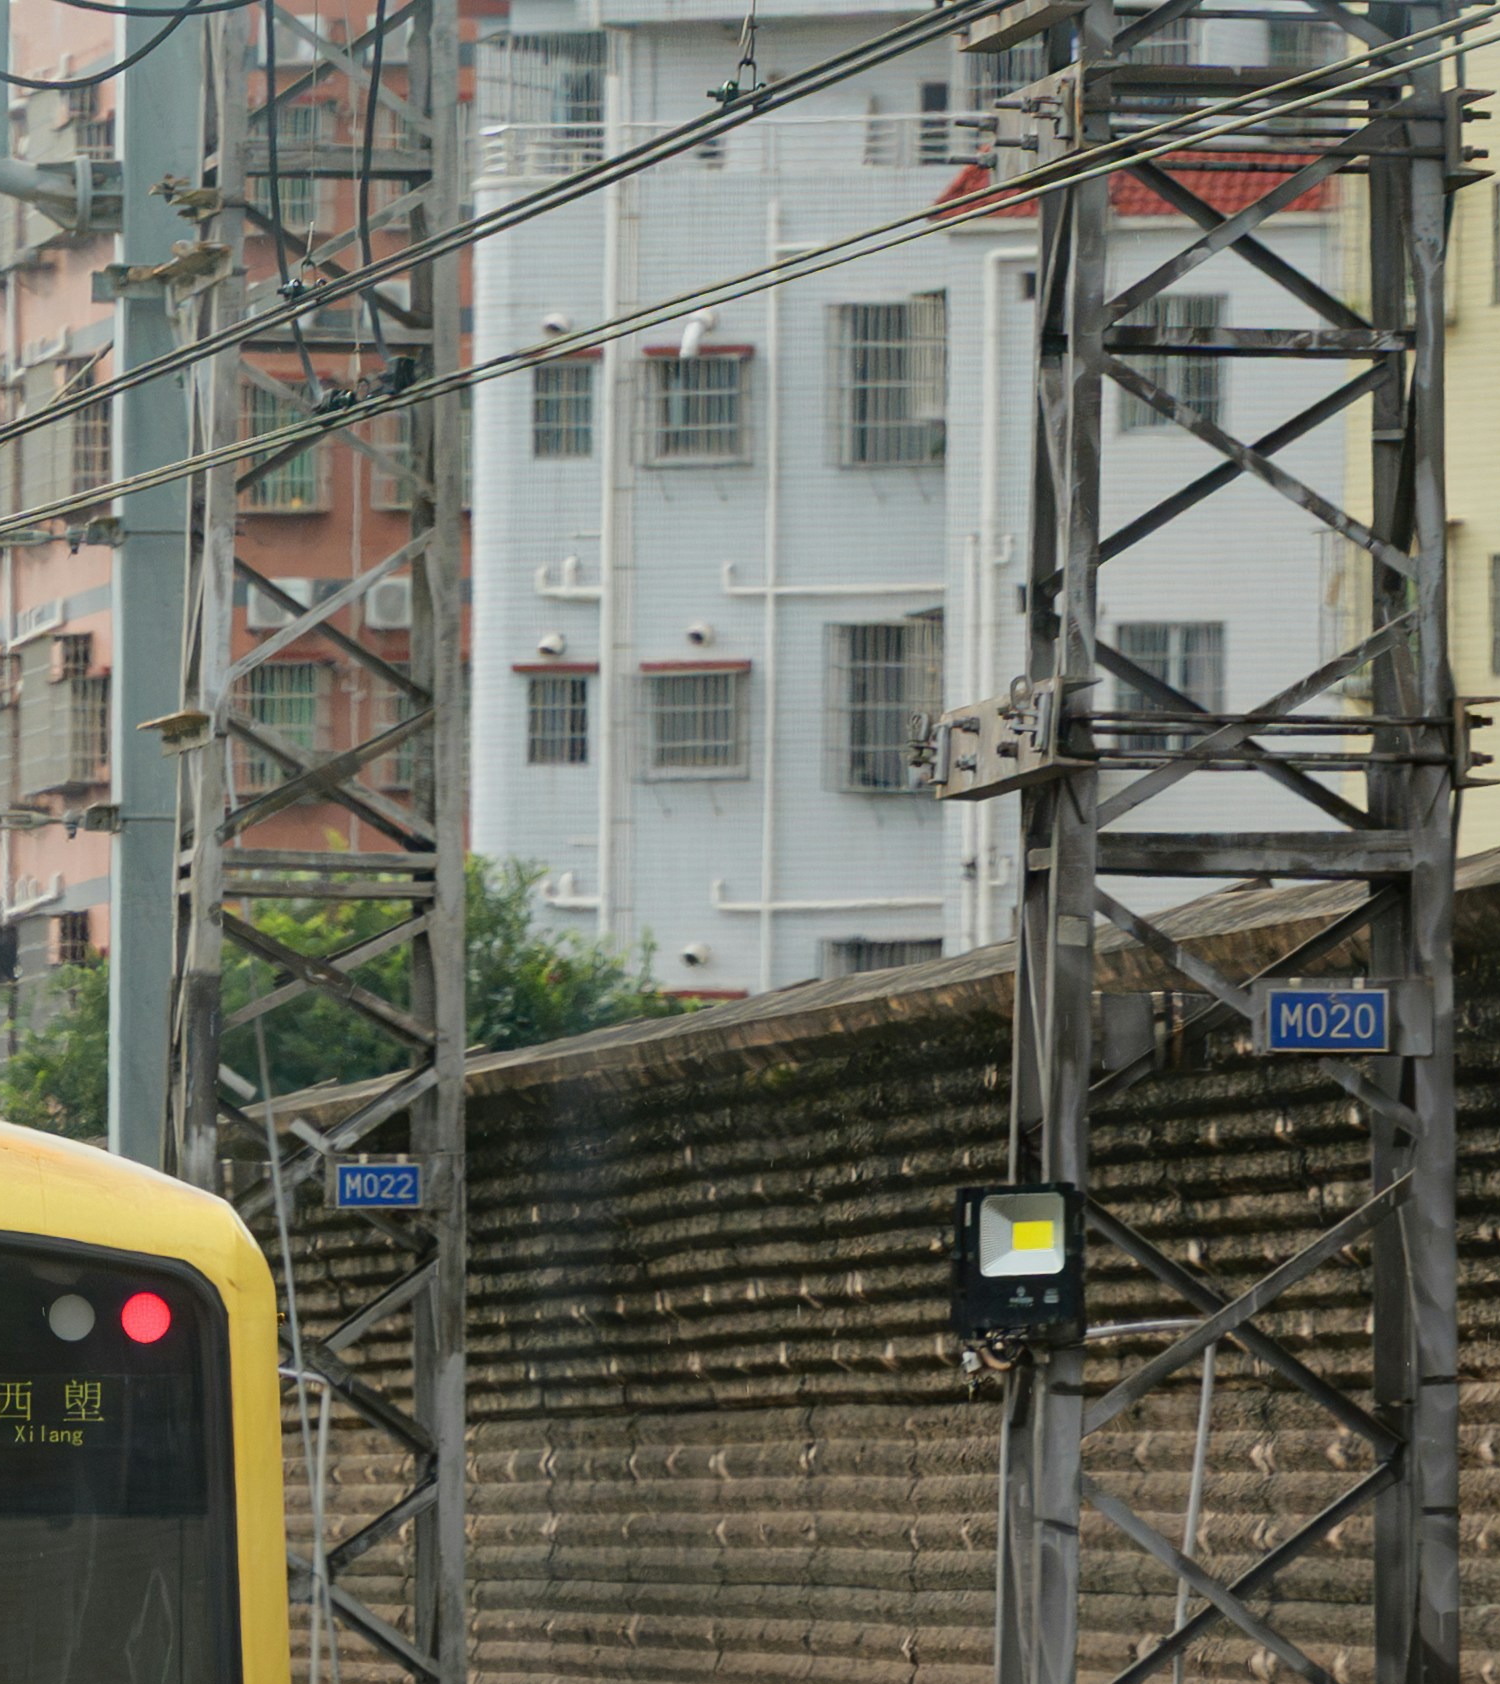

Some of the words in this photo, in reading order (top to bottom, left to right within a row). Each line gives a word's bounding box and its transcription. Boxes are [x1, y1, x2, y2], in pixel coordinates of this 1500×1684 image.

[1280, 1003, 1376, 1039] M020
[344, 1172, 414, 1200] M022
[13, 1424, 84, 1446] Xilang
